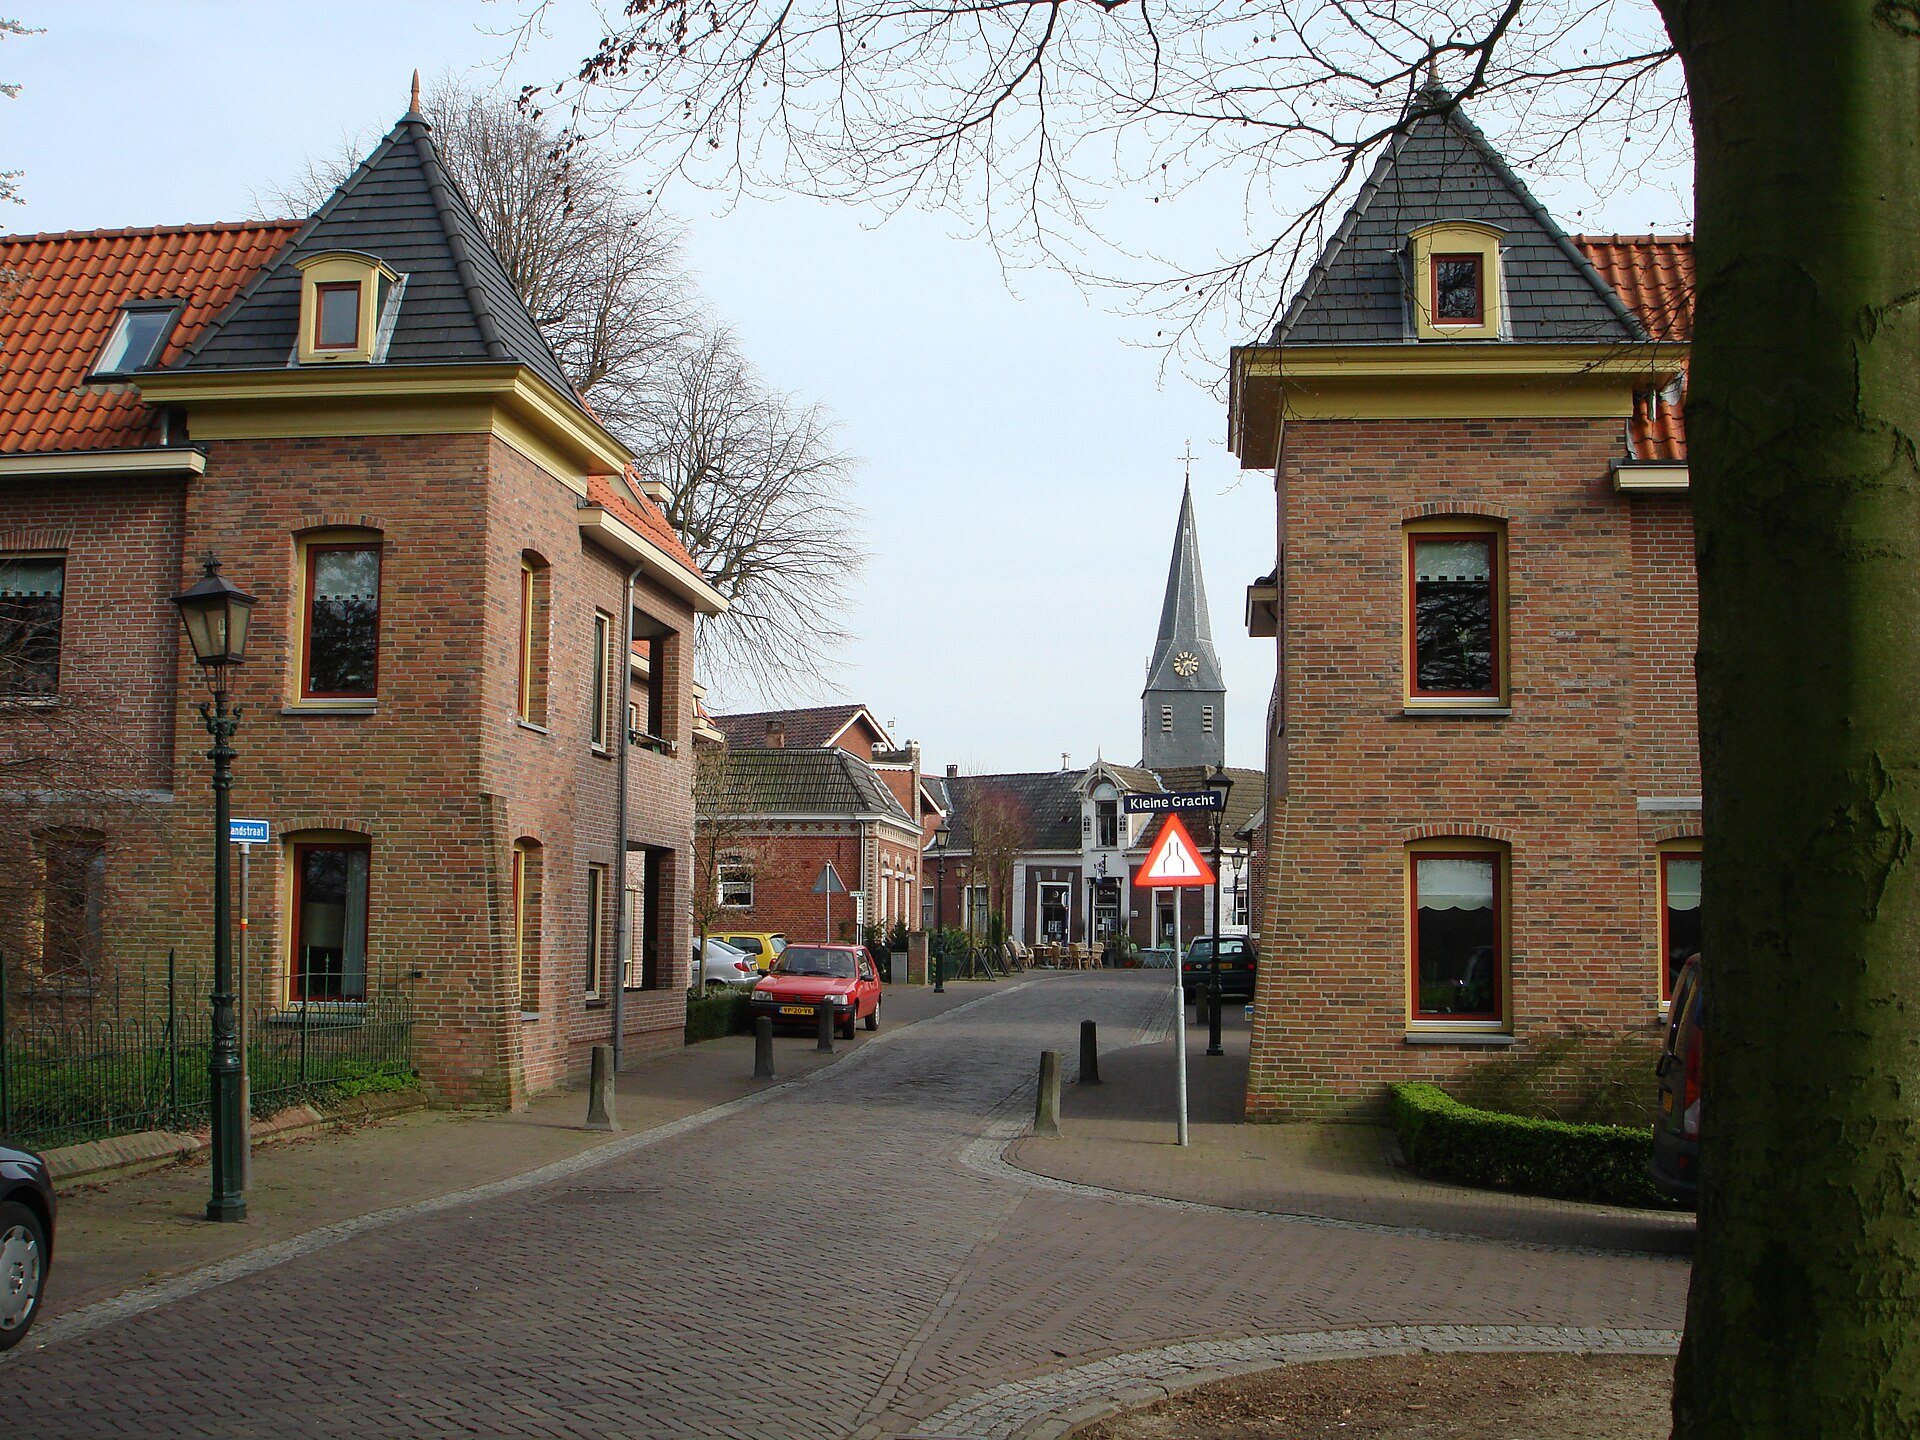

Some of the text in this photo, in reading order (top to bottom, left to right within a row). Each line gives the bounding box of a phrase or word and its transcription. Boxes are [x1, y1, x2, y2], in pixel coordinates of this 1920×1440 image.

[1130, 795, 1215, 809] Kleine Gracht
[230, 825, 264, 837] andstraat
